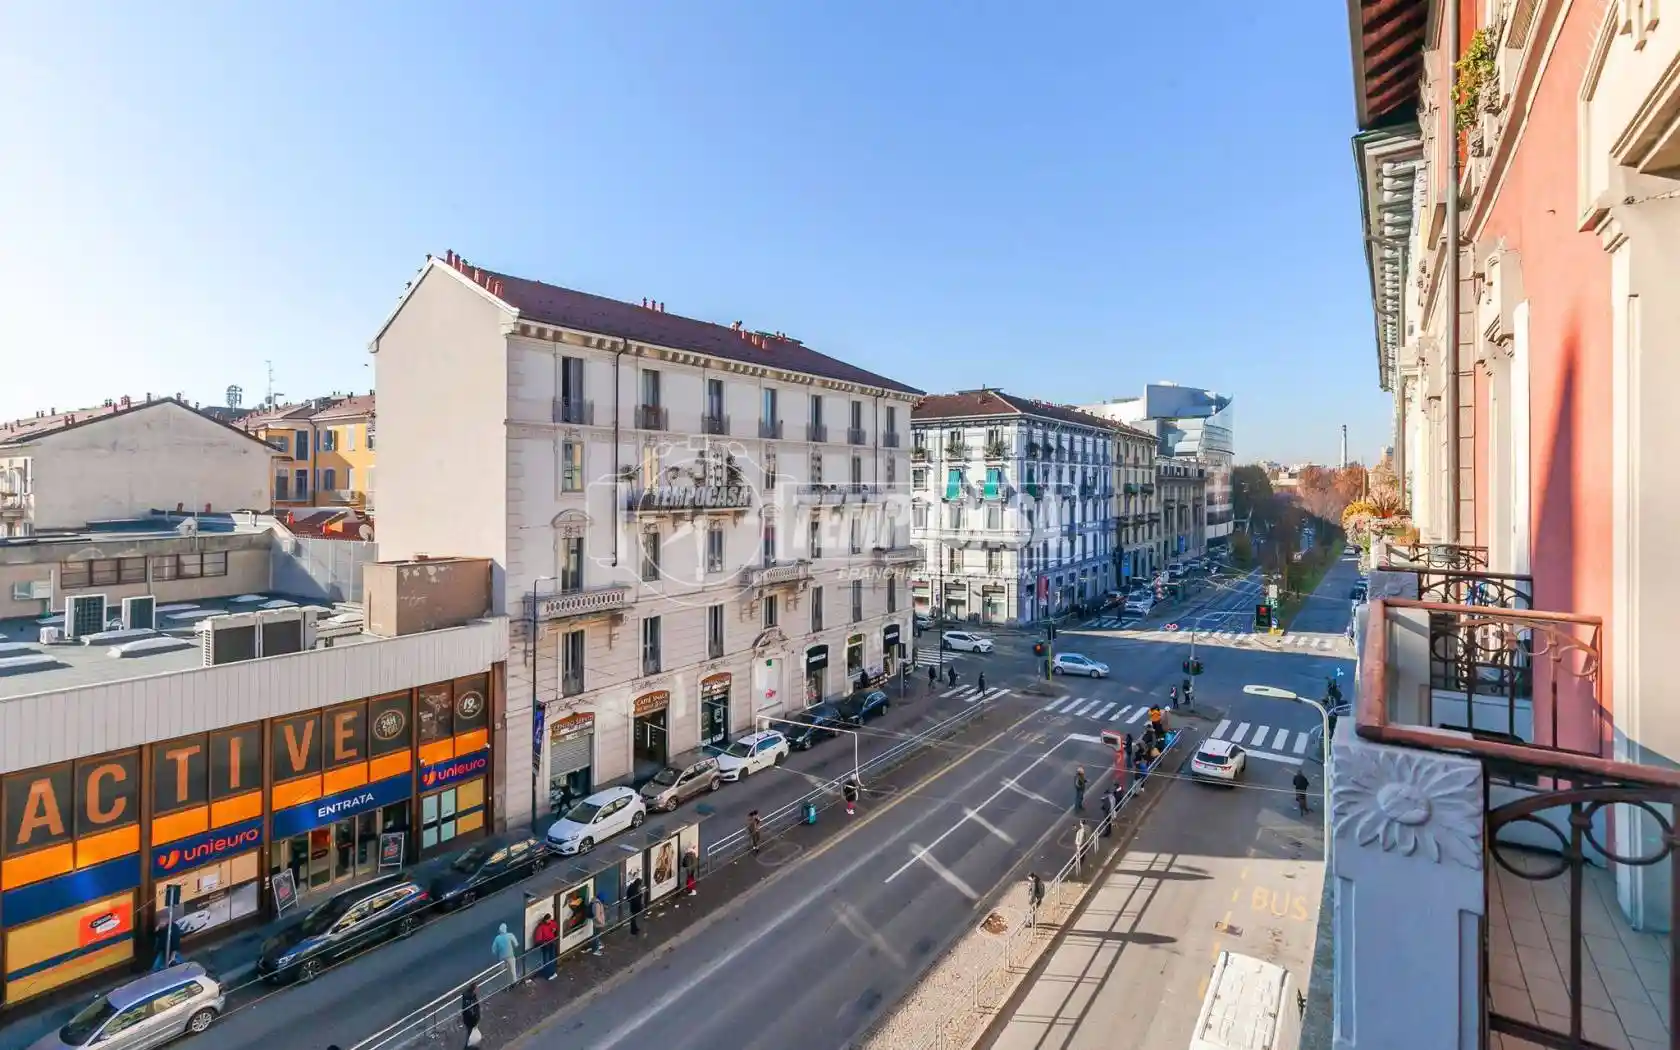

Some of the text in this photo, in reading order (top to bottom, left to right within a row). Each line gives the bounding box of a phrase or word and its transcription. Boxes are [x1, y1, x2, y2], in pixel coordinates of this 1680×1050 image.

[16, 711, 359, 845] ACTIVE
[438, 758, 486, 781] unieuro
[318, 792, 375, 818] ENTRATA
[184, 828, 259, 861] unieuro
[1251, 887, 1309, 921] BUS
